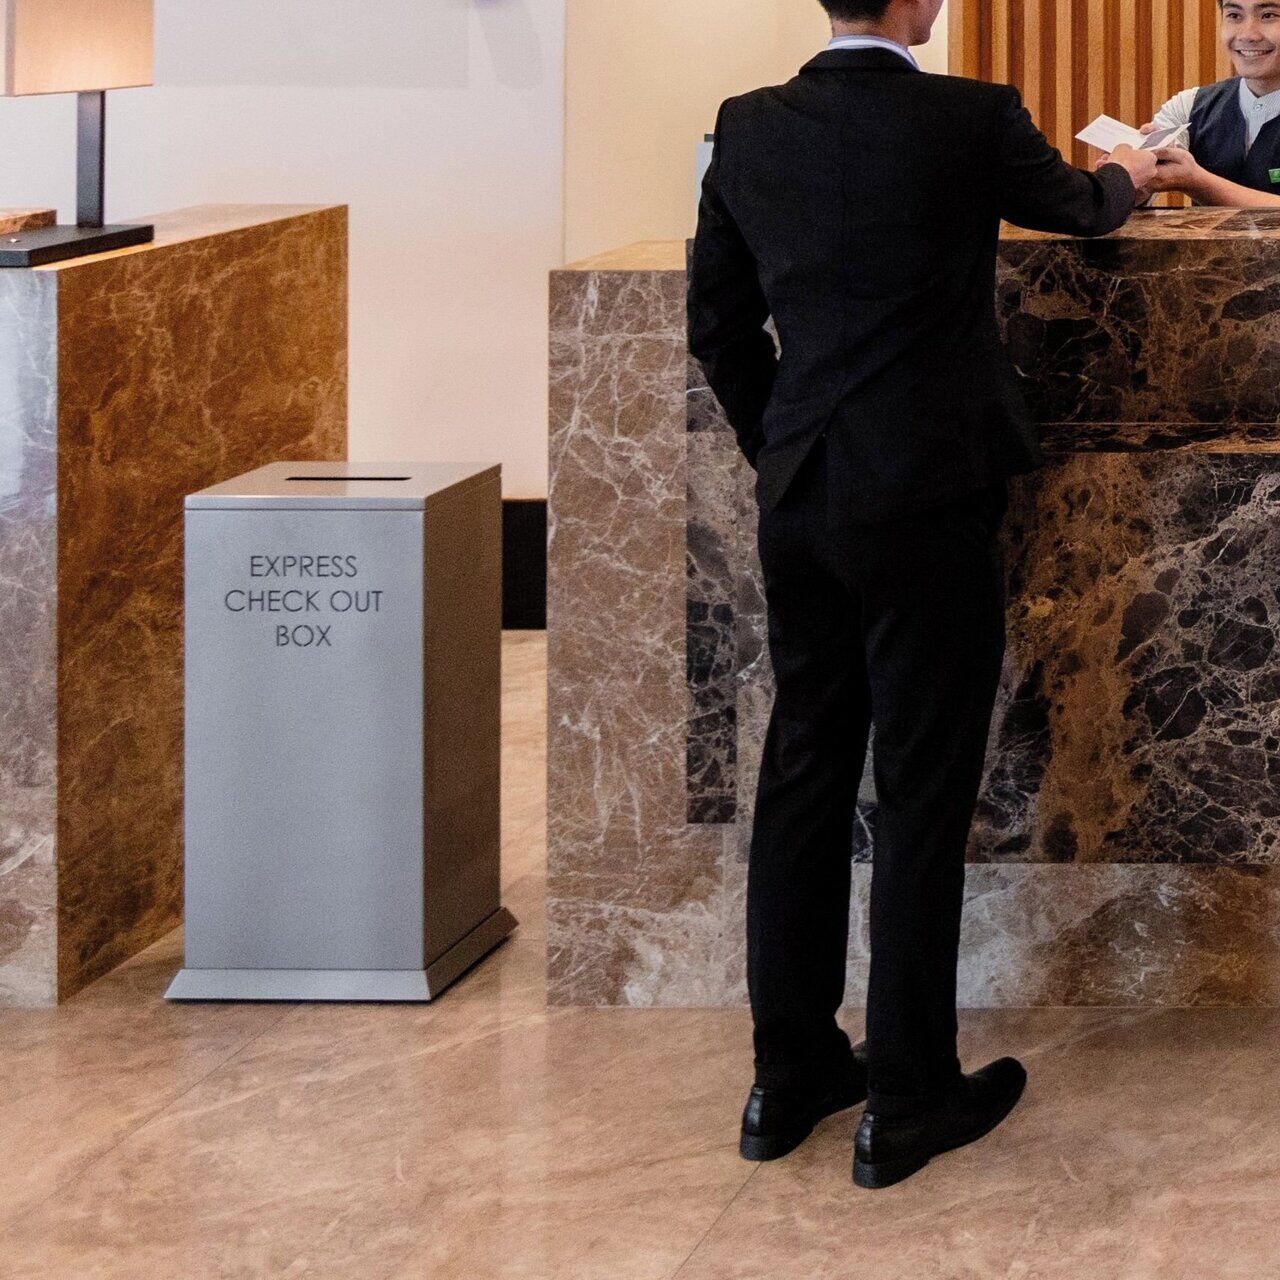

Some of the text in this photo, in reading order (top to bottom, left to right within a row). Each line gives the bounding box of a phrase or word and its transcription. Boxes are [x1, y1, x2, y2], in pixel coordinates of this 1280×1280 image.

[250, 555, 358, 578] EXPRESS
[225, 589, 384, 612] CHECK OUT
[276, 624, 333, 647] BOX
